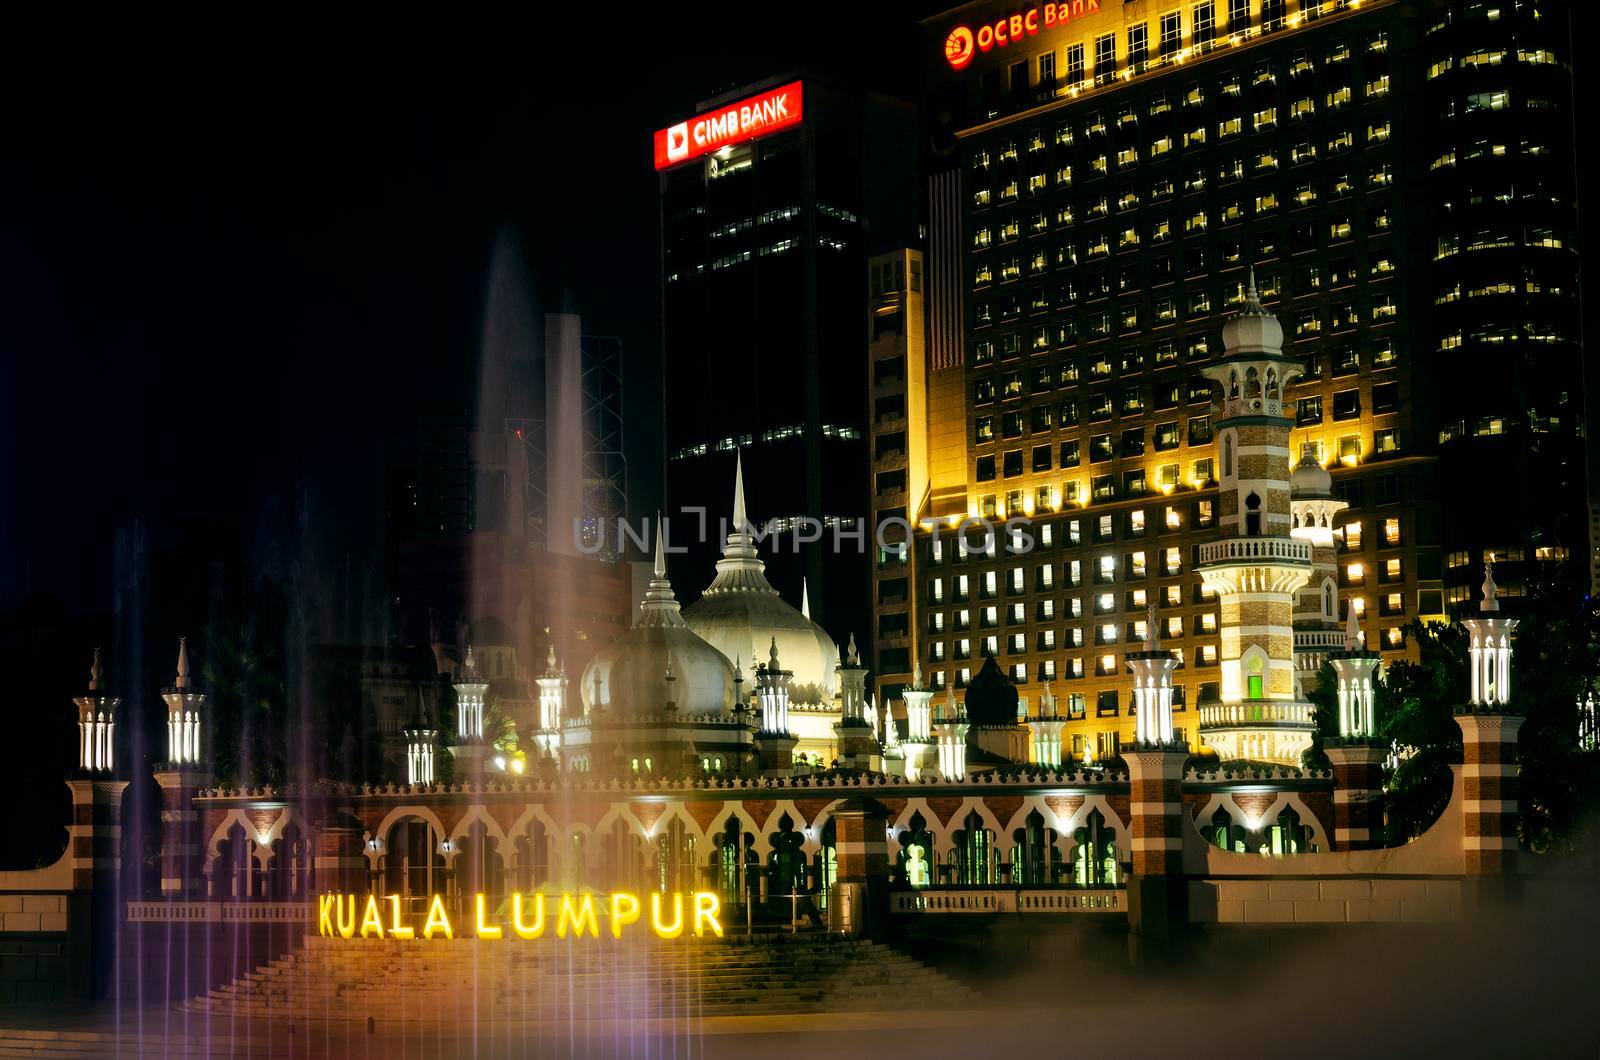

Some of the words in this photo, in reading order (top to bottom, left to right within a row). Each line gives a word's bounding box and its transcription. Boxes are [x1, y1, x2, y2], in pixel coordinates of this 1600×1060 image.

[977, 9, 1037, 48] OCBC
[693, 111, 739, 146] CIMB
[740, 93, 788, 131] BANK
[319, 894, 454, 940] KUALA
[475, 891, 724, 940] LUMPUR
